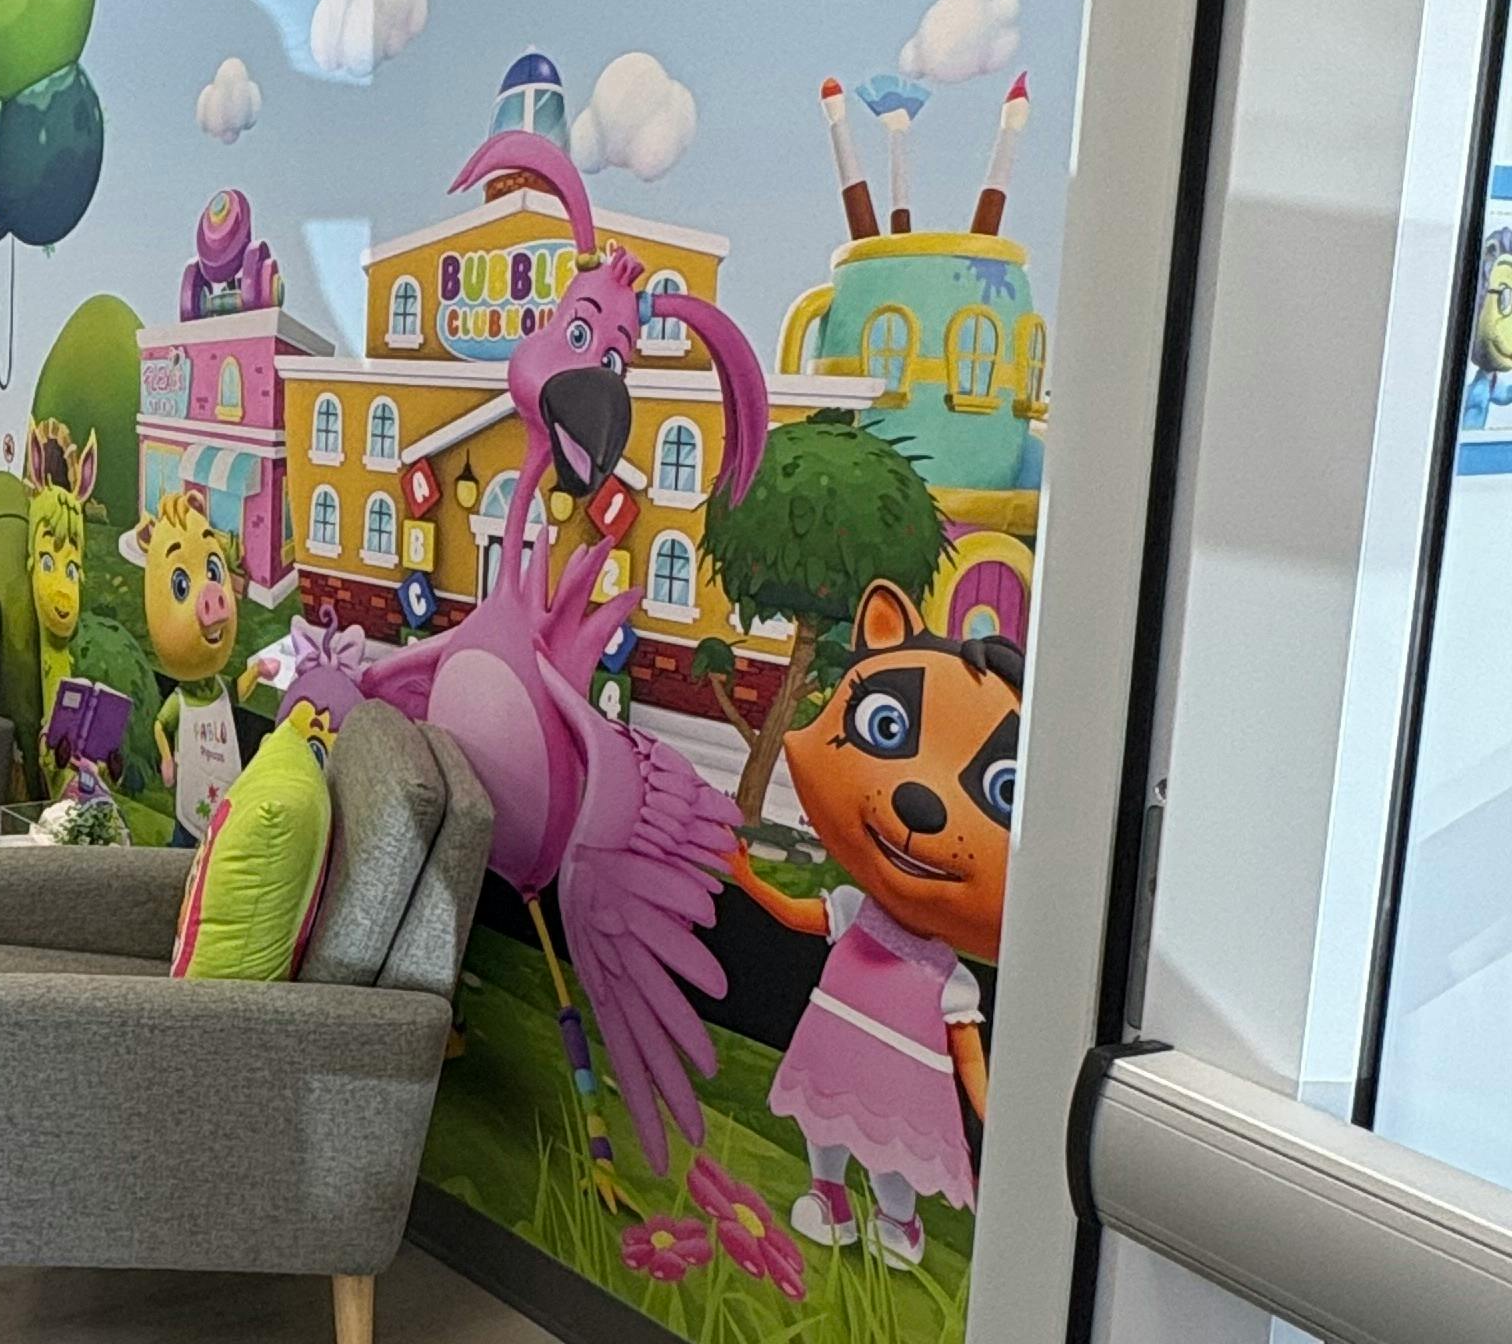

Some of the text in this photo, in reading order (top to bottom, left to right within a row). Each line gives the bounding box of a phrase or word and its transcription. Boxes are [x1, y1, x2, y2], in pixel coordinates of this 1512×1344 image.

[412, 470, 430, 504] A
[604, 492, 624, 525] 1
[408, 527, 426, 563] B
[602, 558, 620, 597] 2
[408, 581, 427, 617] C
